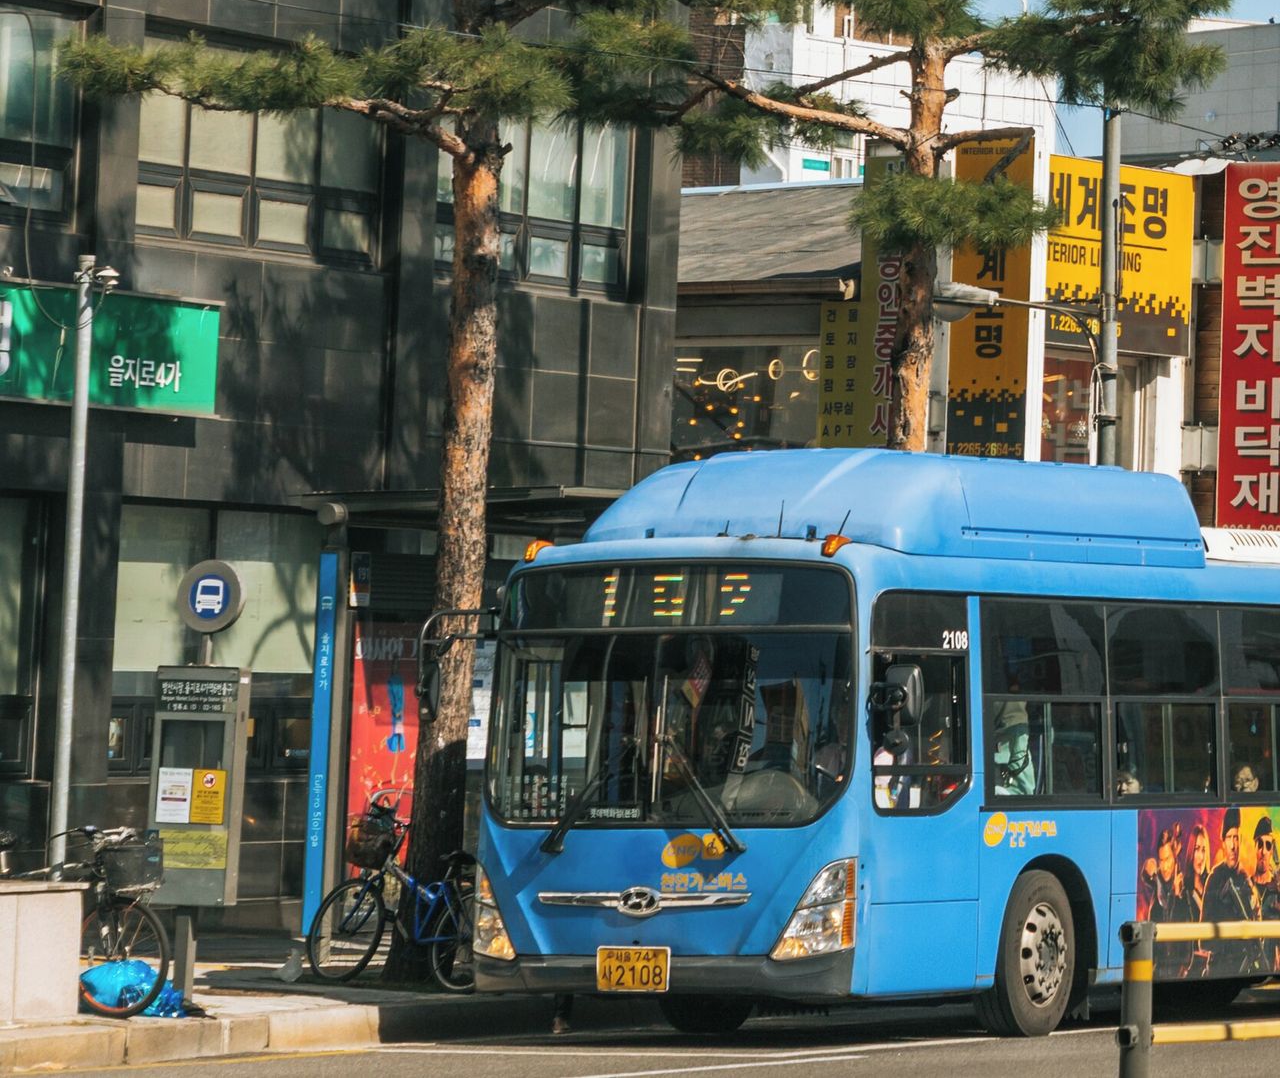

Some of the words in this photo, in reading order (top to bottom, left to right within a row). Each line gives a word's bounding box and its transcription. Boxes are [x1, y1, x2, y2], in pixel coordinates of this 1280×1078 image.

[108, 355, 181, 393] 을지로4가
[942, 630, 968, 650] 2108
[615, 950, 632, 962] 서울
[635, 950, 652, 962] 74
